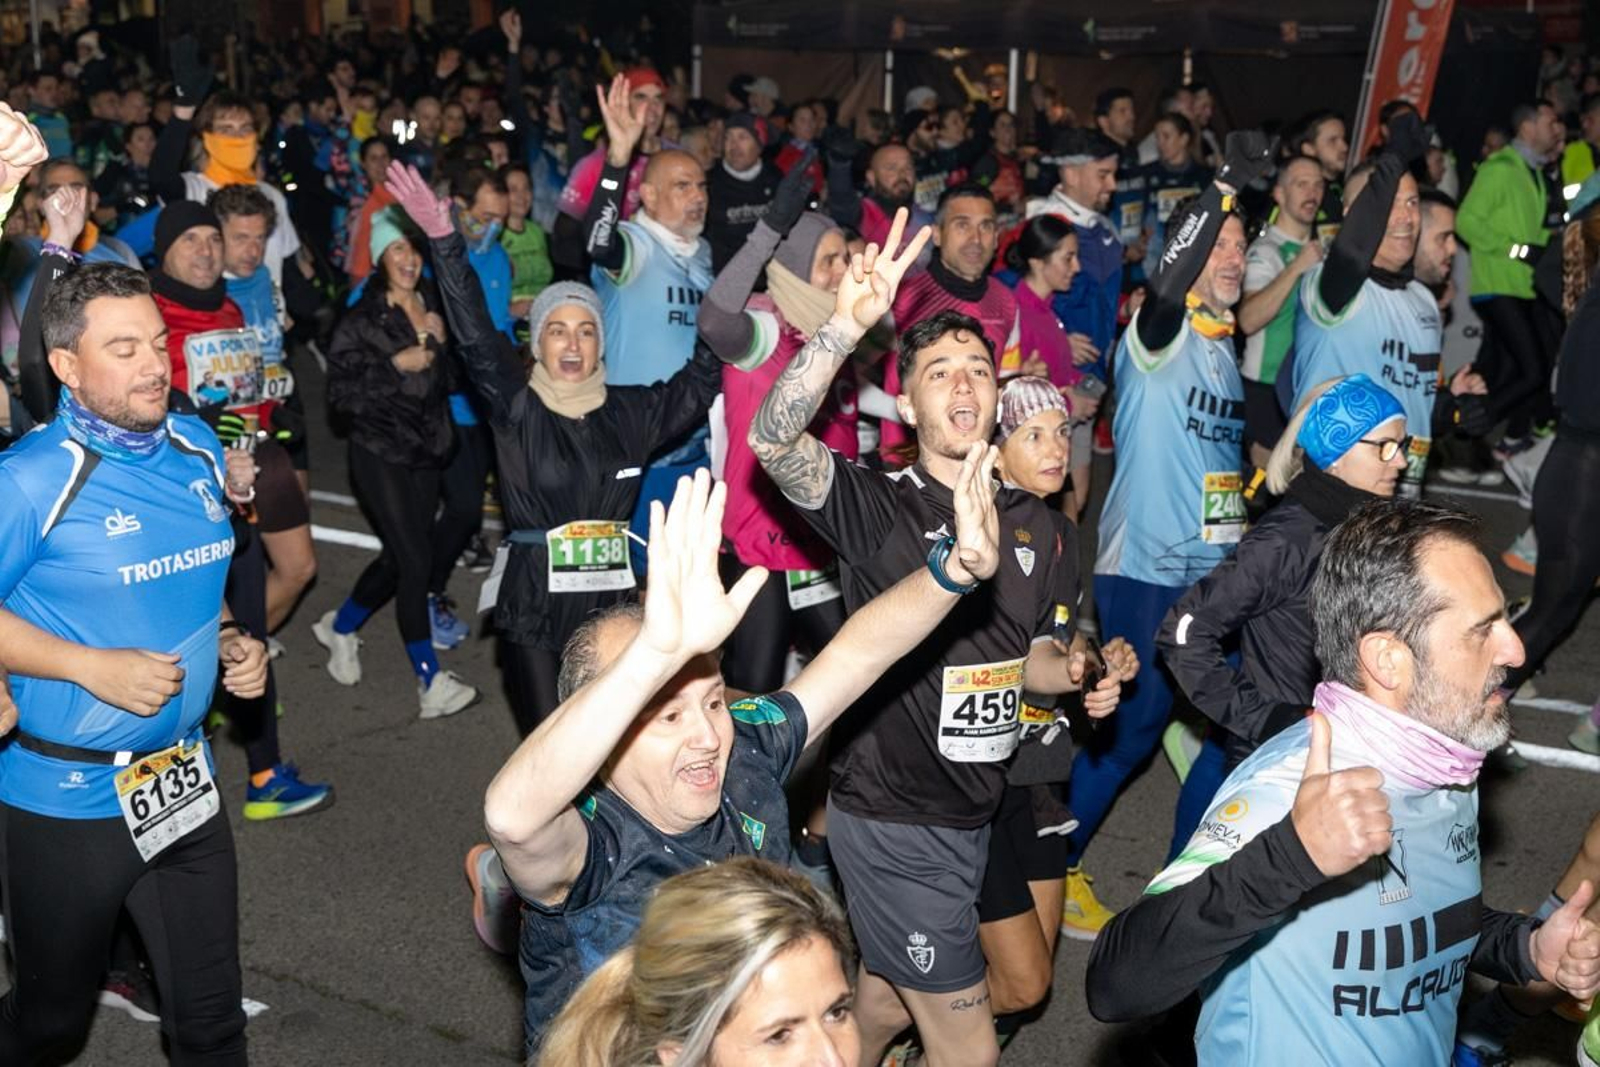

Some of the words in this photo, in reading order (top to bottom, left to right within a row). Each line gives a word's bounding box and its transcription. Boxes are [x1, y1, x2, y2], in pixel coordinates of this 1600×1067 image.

[559, 538, 623, 565] 1138
[972, 670, 991, 687] 42
[953, 689, 1017, 726] 459
[130, 757, 200, 821] 6135
